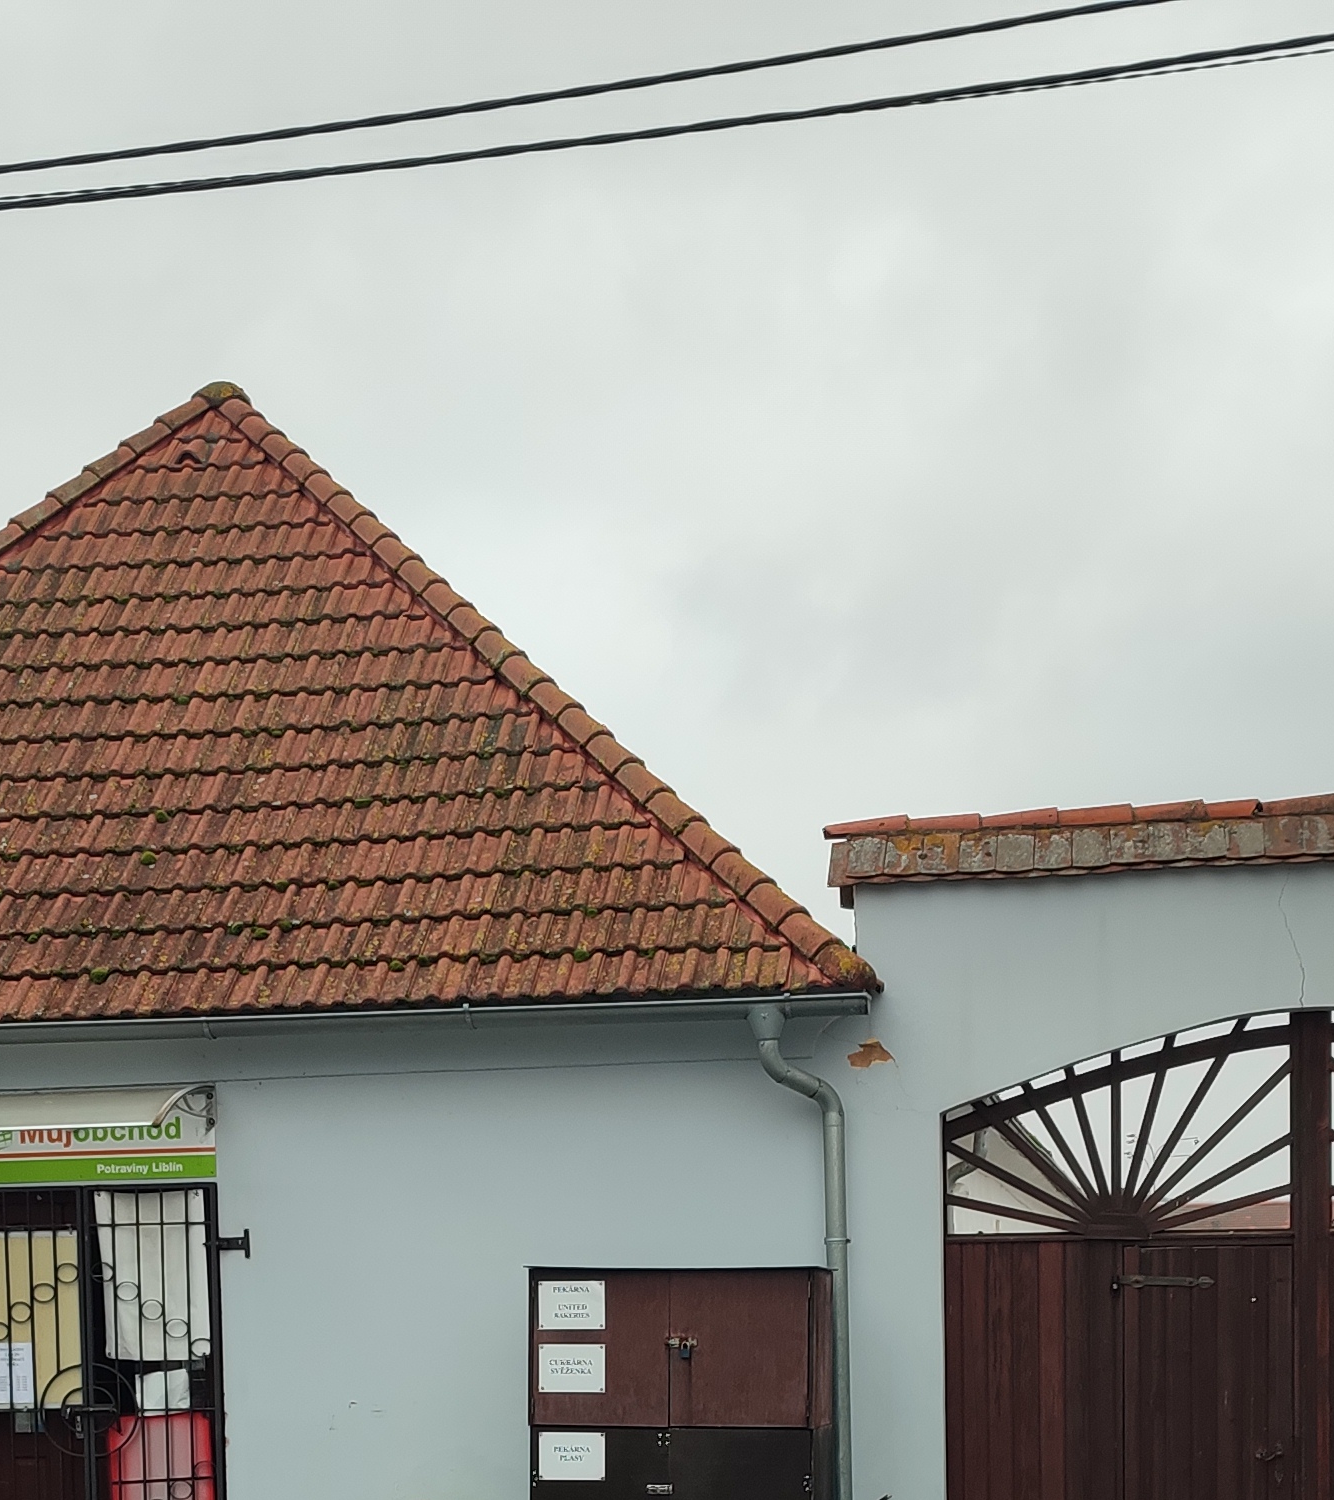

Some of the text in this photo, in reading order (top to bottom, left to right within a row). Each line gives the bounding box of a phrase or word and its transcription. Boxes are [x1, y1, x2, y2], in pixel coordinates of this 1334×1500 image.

[96, 1161, 183, 1175] Potraviny Liblín
[552, 1285, 590, 1293] PEKÁRNA
[553, 1445, 591, 1453] PEKÁRNA
[559, 1454, 585, 1462] PLASY
